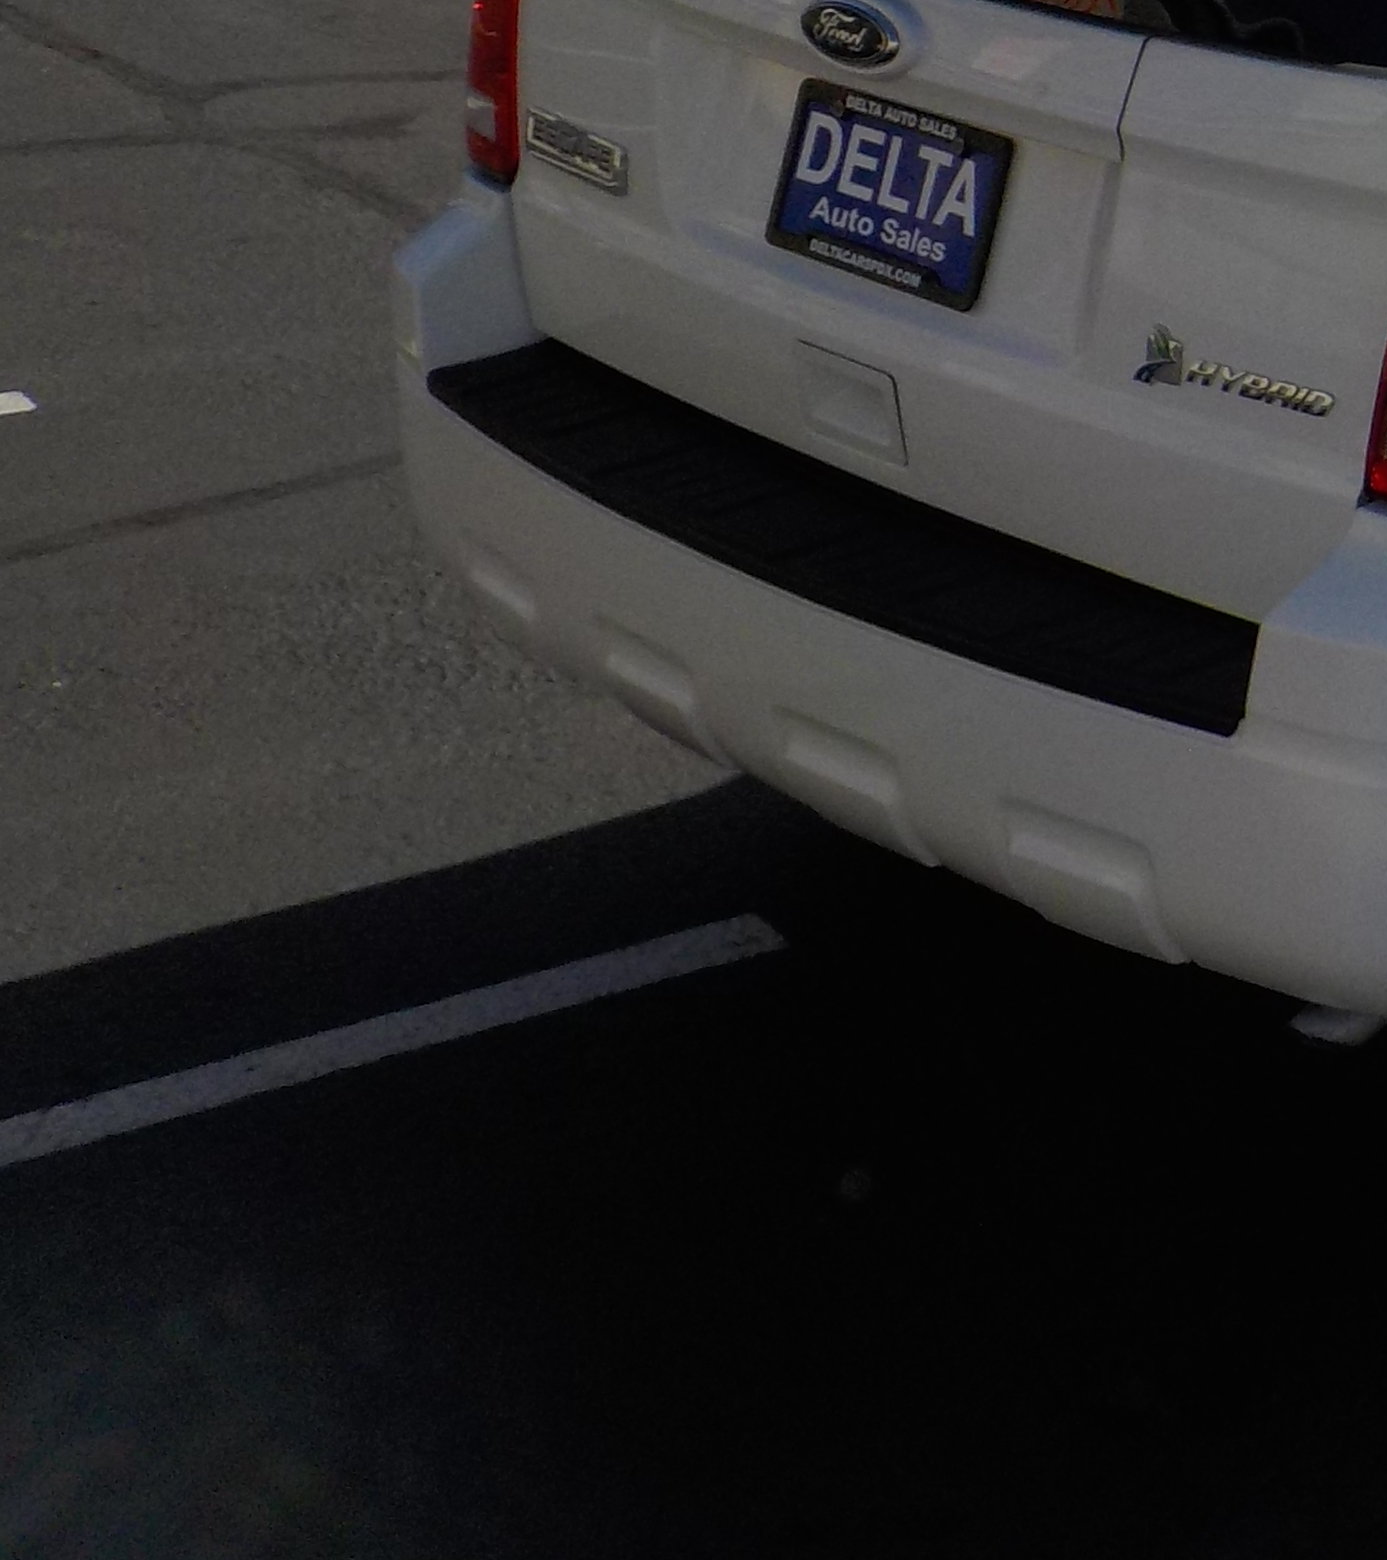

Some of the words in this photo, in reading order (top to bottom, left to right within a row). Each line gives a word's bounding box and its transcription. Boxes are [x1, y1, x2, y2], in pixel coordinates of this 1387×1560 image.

[813, 7, 865, 52] Ford
[845, 94, 882, 118] DELTA
[884, 105, 919, 130] AUTO
[919, 116, 957, 141] SALES
[796, 110, 976, 238] DELTA
[809, 196, 875, 237] Auto
[880, 217, 947, 264] Sales
[1185, 359, 1336, 417] HYBRID
